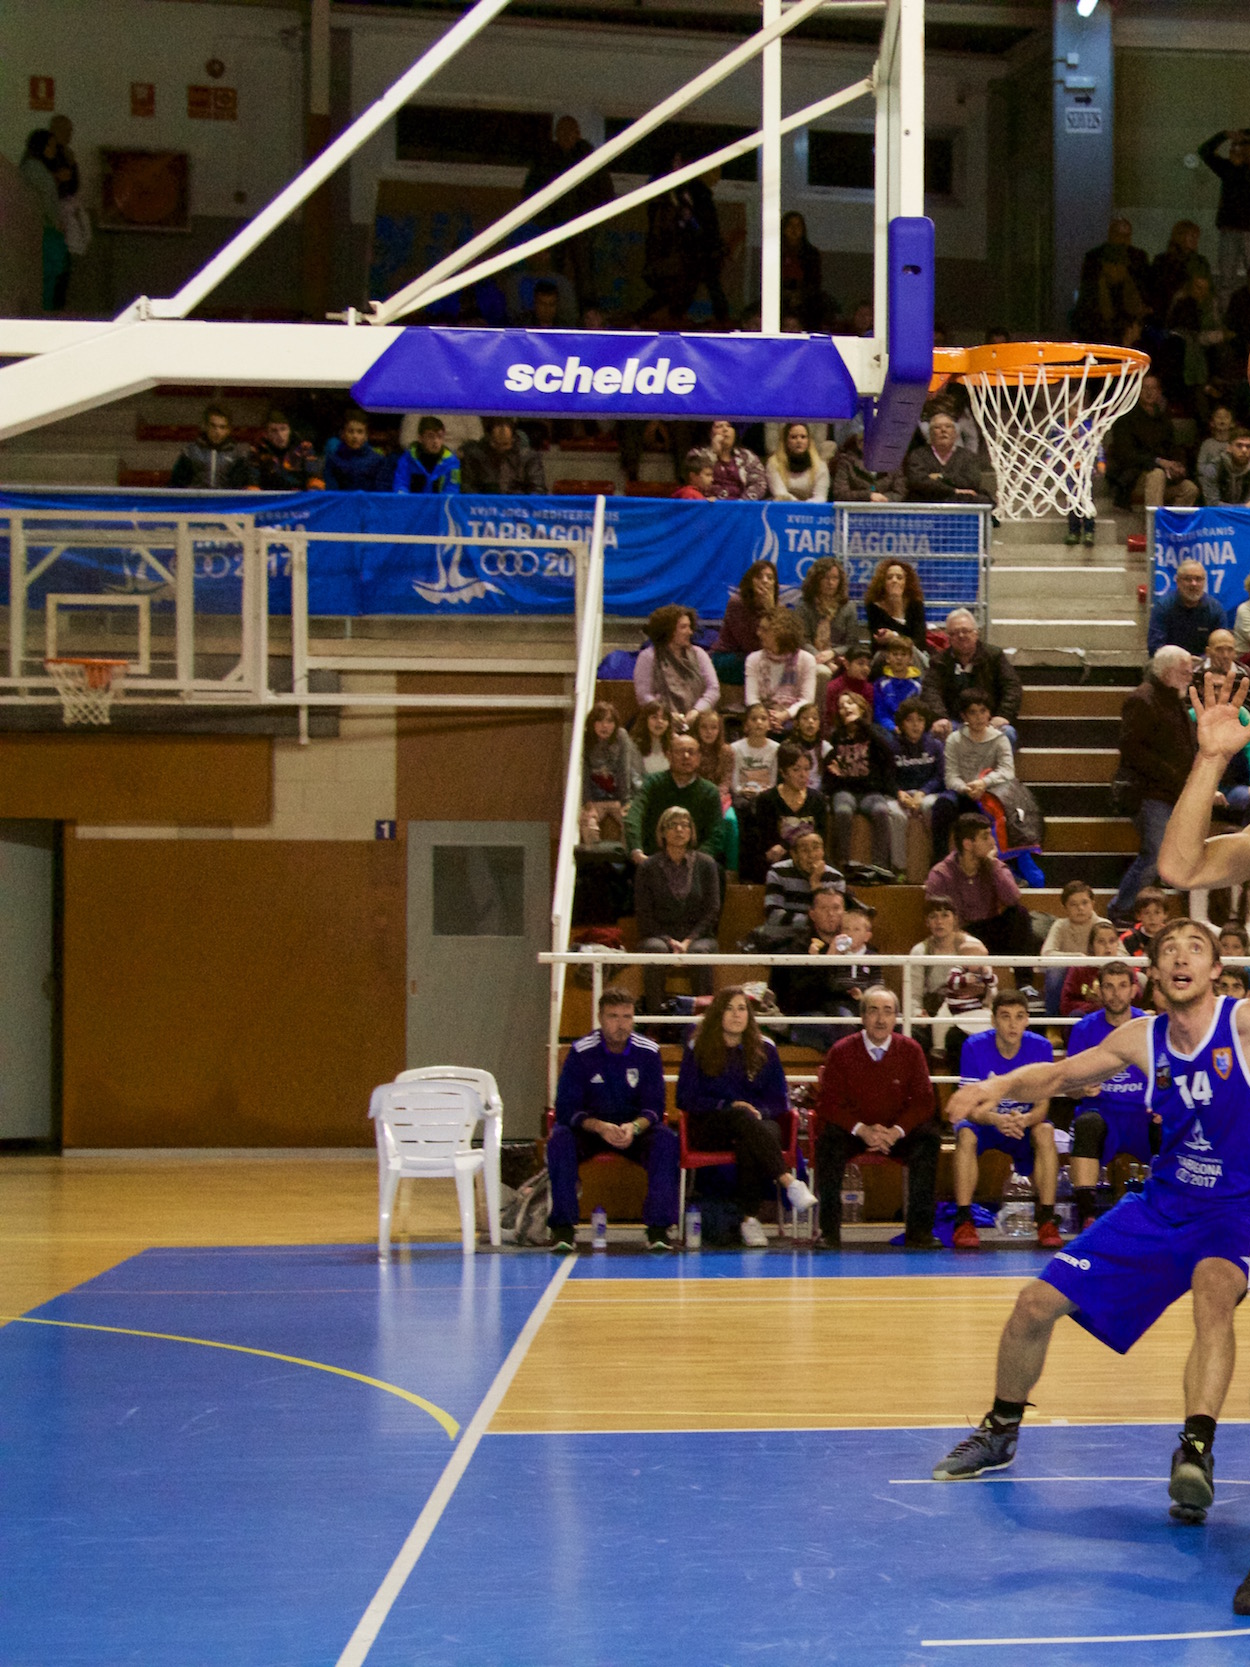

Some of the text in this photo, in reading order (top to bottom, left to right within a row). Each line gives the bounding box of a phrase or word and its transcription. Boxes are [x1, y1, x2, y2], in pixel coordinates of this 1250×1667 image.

[504, 356, 697, 393] schelde
[532, 509, 619, 522] MEDITERRNIS
[817, 516, 840, 526] JOC
[543, 552, 576, 577] 20
[1155, 540, 1238, 569] RAGONA
[1173, 1069, 1214, 1110] 14
